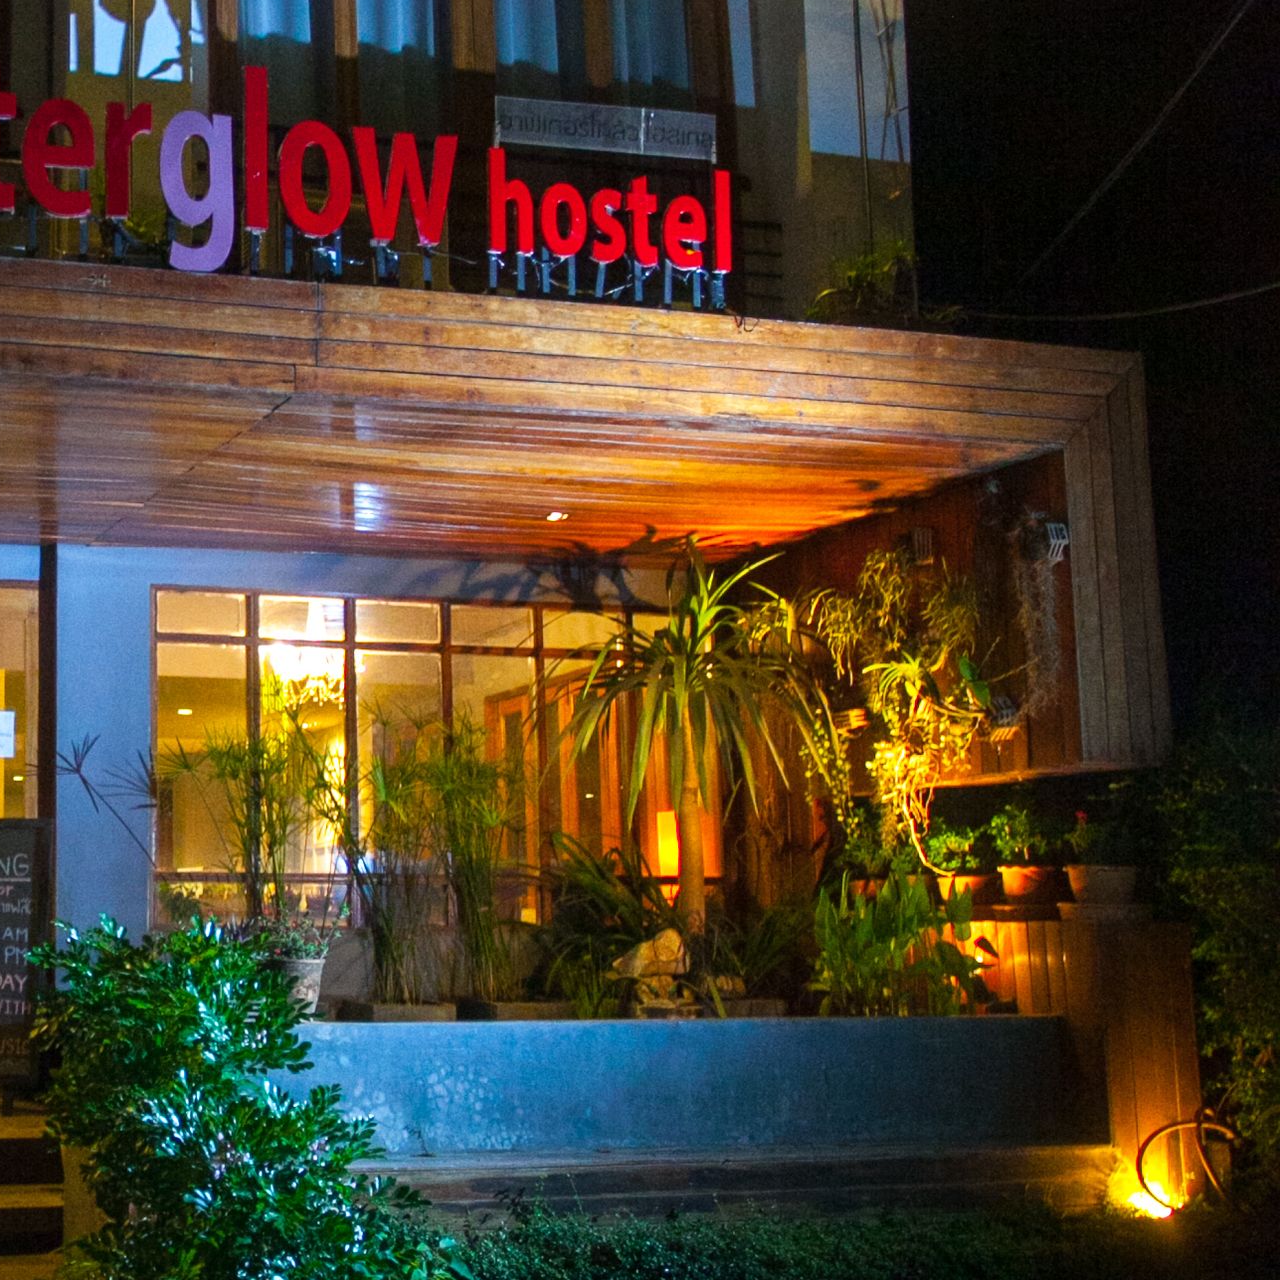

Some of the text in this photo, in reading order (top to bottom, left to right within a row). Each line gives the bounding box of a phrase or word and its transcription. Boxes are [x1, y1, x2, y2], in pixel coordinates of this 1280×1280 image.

[487, 146, 732, 273] hostel
[2, 927, 29, 943] AM
[4, 946, 29, 966] PM
